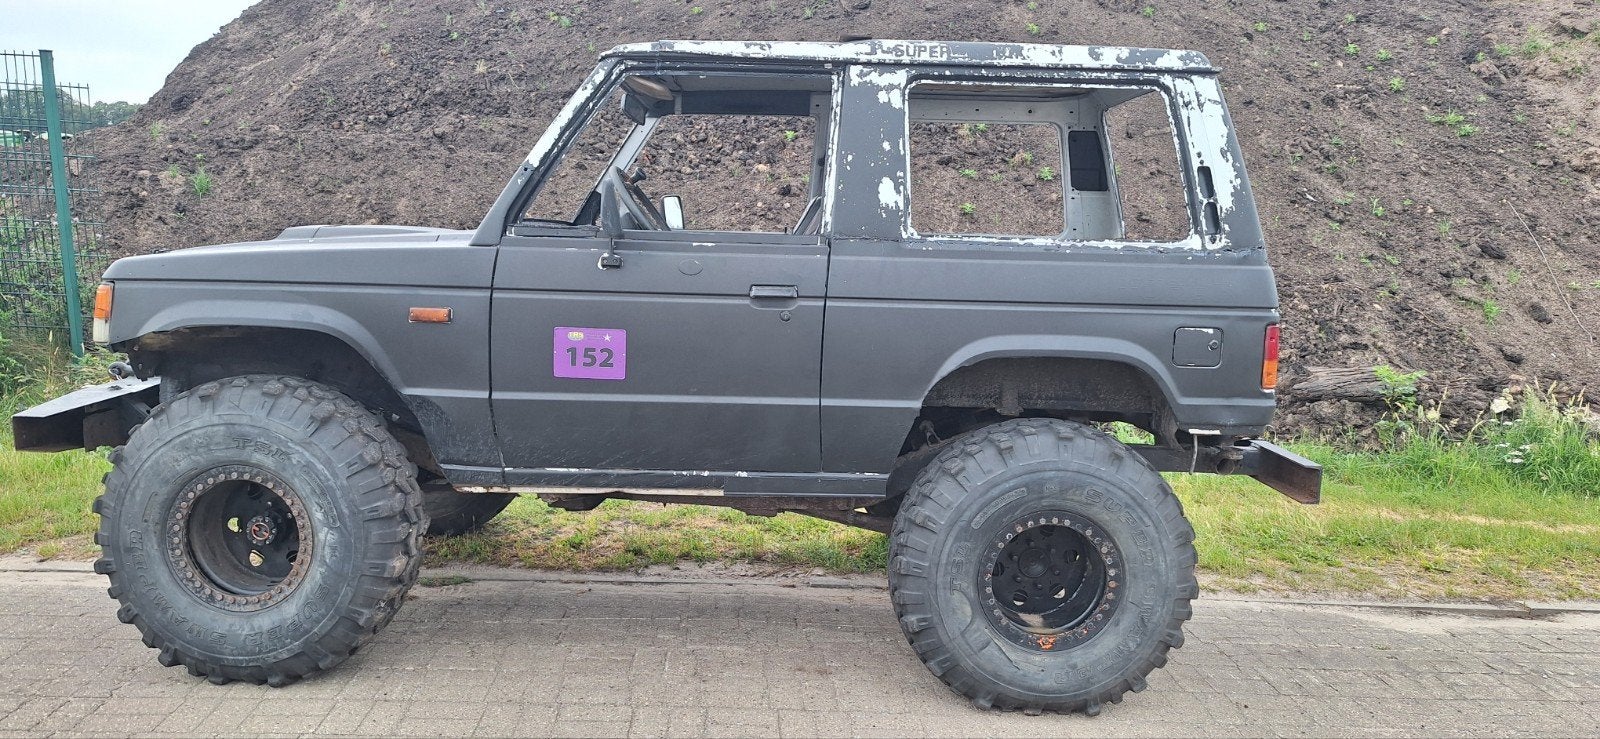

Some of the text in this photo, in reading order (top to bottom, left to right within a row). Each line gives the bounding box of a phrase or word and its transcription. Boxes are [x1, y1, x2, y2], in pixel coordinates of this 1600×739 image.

[893, 44, 950, 59] SUPER
[567, 347, 613, 367] 152
[233, 437, 294, 462] TSL
[1084, 487, 1158, 569] SUPER
[246, 583, 333, 647] SUPER
